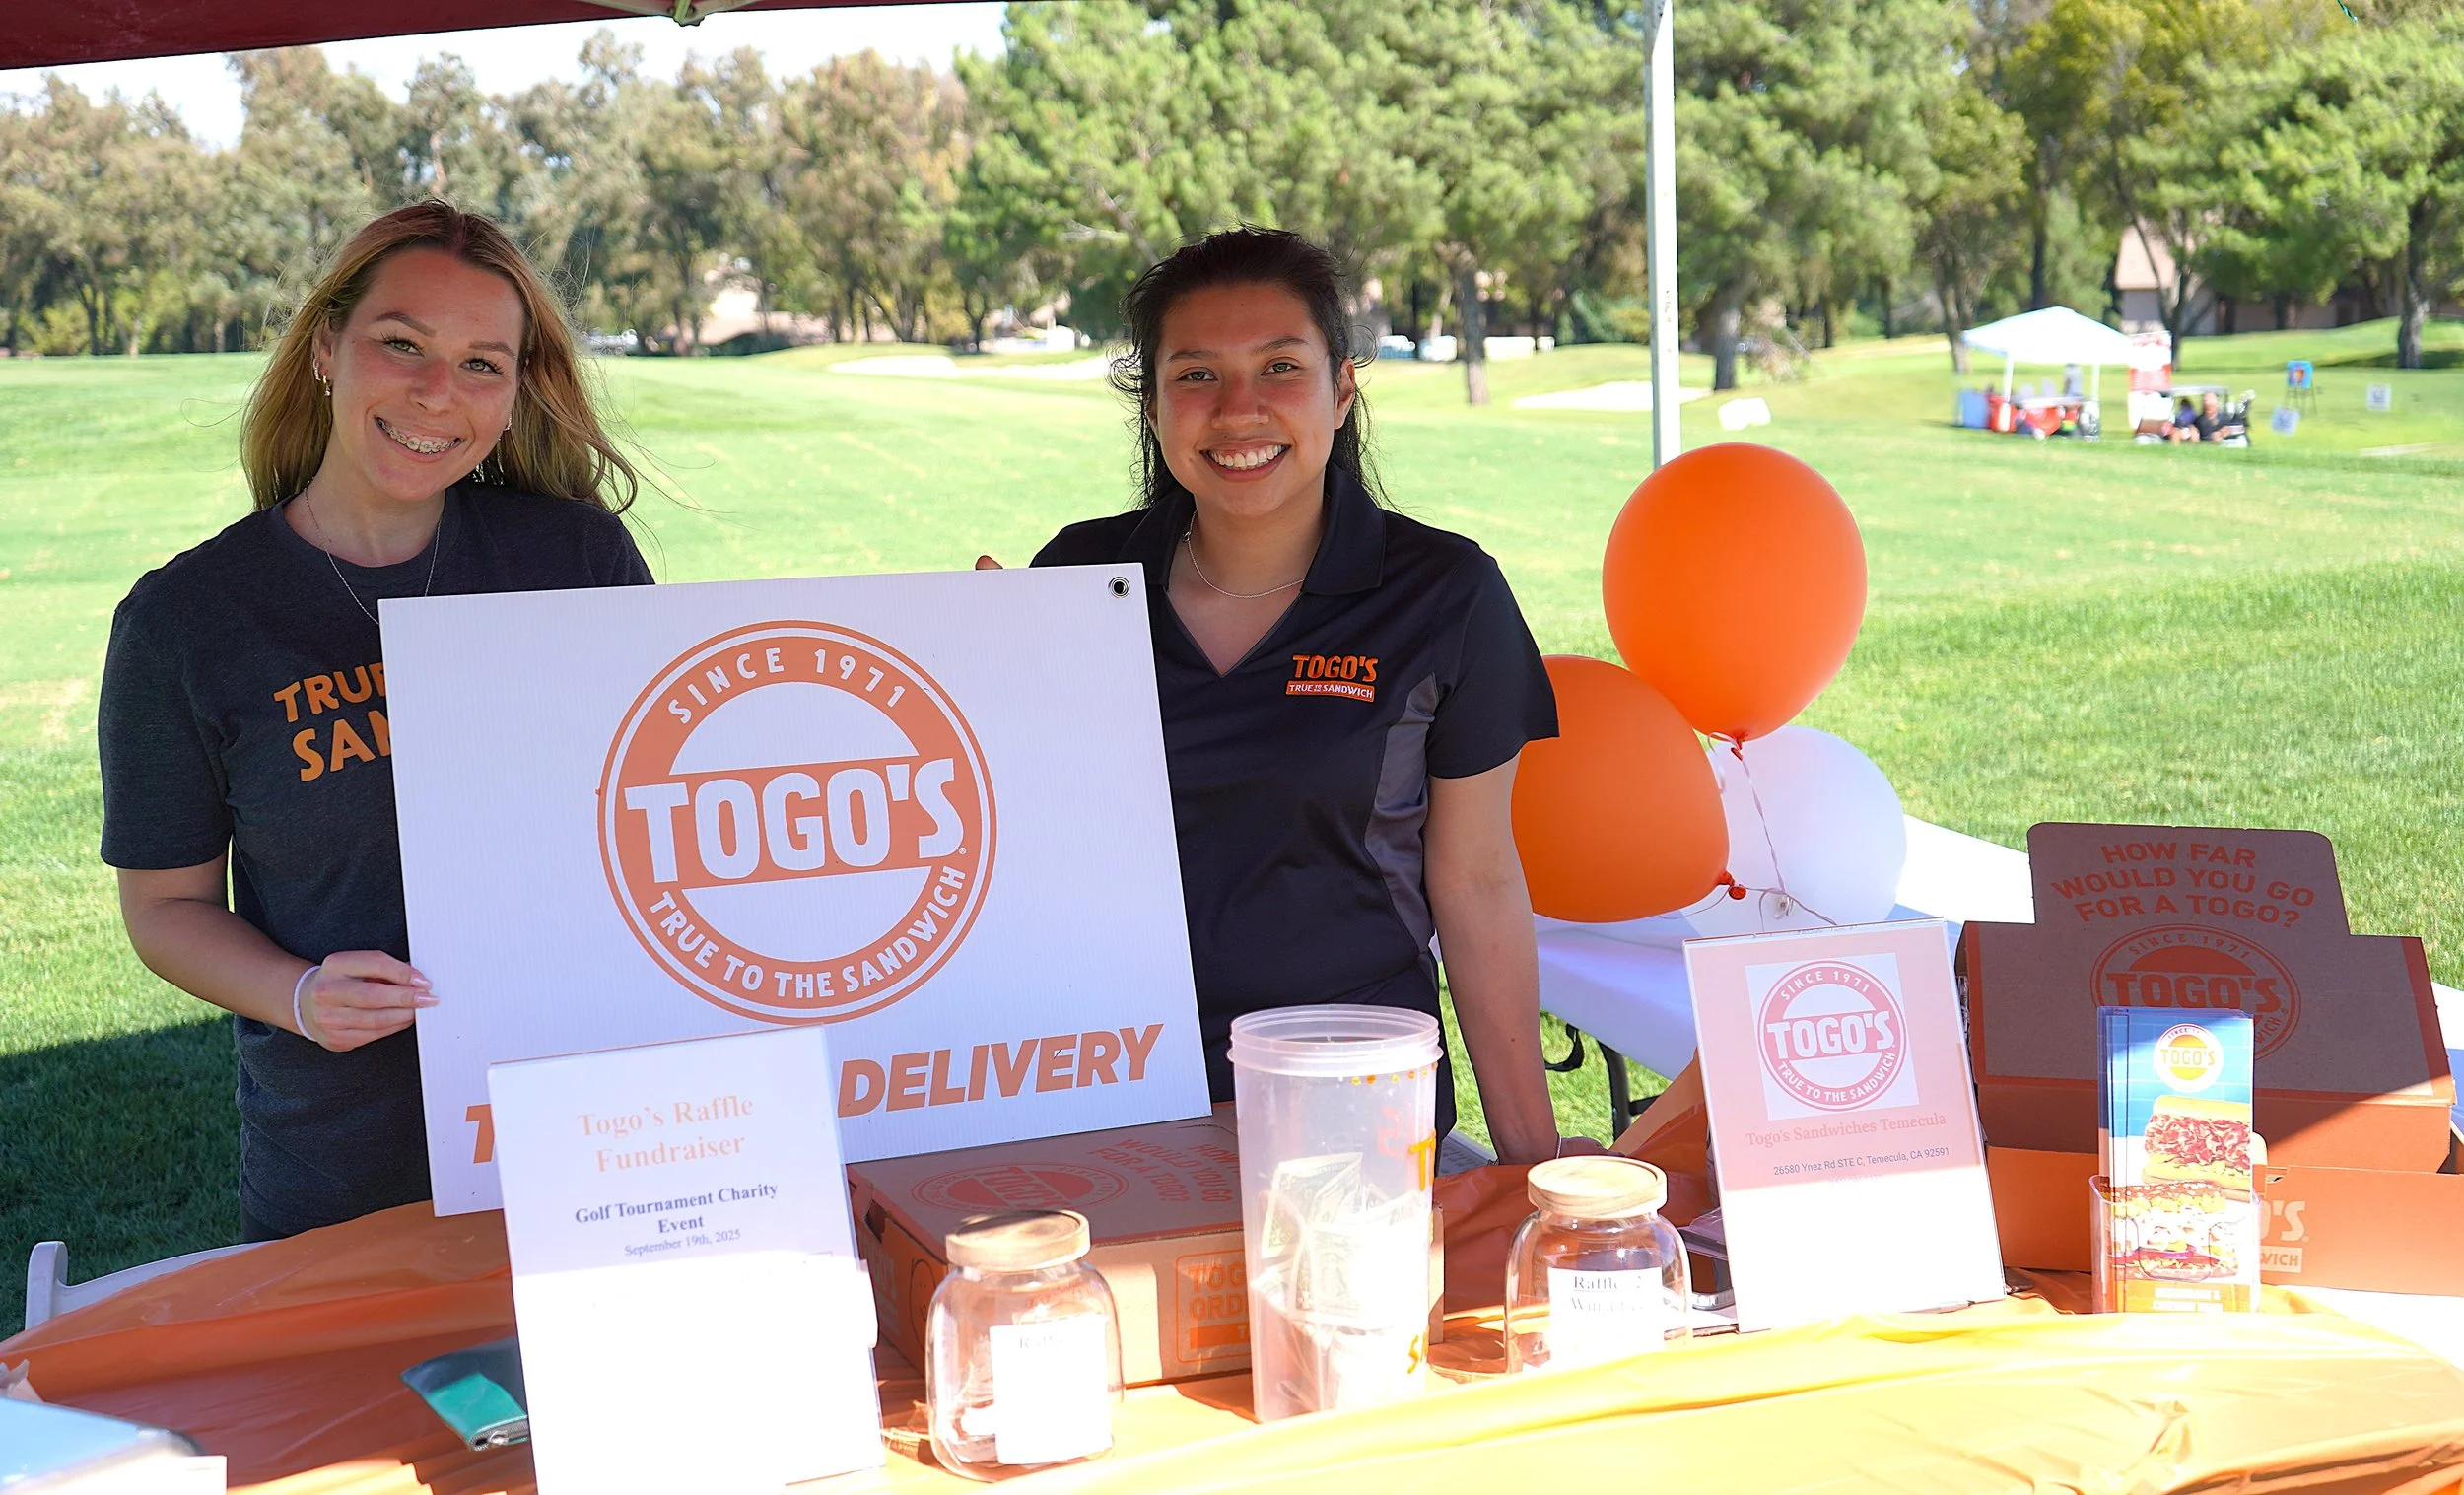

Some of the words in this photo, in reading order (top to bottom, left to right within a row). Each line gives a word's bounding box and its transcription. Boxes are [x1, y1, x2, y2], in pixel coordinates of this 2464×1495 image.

[1292, 654, 1379, 682] TOGO'S
[668, 647, 785, 724] SINCE
[814, 648, 906, 708] 1971
[1323, 684, 1373, 698] SANDWICH
[624, 758, 965, 883] TOGO'S
[2100, 842, 2177, 864] HOW
[2190, 843, 2256, 868] FAR
[2050, 867, 2176, 900] WOULD
[2186, 868, 2256, 893] YOU
[2266, 881, 2315, 907] GO
[2074, 895, 2146, 923] FOR
[2154, 894, 2179, 915] A
[2185, 894, 2301, 928] TOGO?
[649, 890, 720, 969] TRUE
[723, 954, 764, 991] TO
[774, 971, 835, 998] THE
[842, 865, 966, 993] SANDWICH
[2128, 933, 2187, 956] SINCE
[2202, 935, 2251, 959] 1971
[1780, 970, 1823, 1001] SINCE
[1833, 970, 1871, 992] 1971
[2105, 972, 2283, 1013] TOGO'S
[1766, 1010, 1895, 1059] TOGO'S
[838, 1023, 1165, 1118] DELIVERY
[2160, 1049, 2216, 1066] TOGO'S
[1777, 1061, 1805, 1091] TRUE
[1806, 1086, 1821, 1099] TO
[1825, 1091, 1848, 1102] THE
[1849, 1052, 1896, 1100] SANDWICH
[673, 1094, 754, 1125] Raffle
[1745, 1129, 1790, 1149] Togo's
[1794, 1121, 1878, 1141] Sandwiches
[1880, 1113, 1947, 1131] Temecula
[596, 1135, 745, 1173] Fundraiser
[1116, 1139, 1202, 1168] WOULD
[1774, 1165, 1801, 1176] 26580
[1802, 1162, 1822, 1173] Ynez
[1824, 1160, 1836, 1170] Rd
[1837, 1157, 1854, 1169] STE
[1857, 1157, 1866, 1167] C,
[1867, 1153, 1909, 1166] Temecula,
[1910, 1150, 1924, 1160] CA
[1925, 1147, 1950, 1159] 92591
[575, 1204, 612, 1224] Golf
[615, 1190, 714, 1218] Tournament
[718, 1184, 779, 1203] Charity
[657, 1214, 705, 1234] Event
[624, 1238, 682, 1257] September
[686, 1234, 713, 1248] 19th,
[715, 1229, 741, 1244] 2025
[1187, 1261, 1247, 1293] TOG
[1189, 1293, 1249, 1321] ORD
